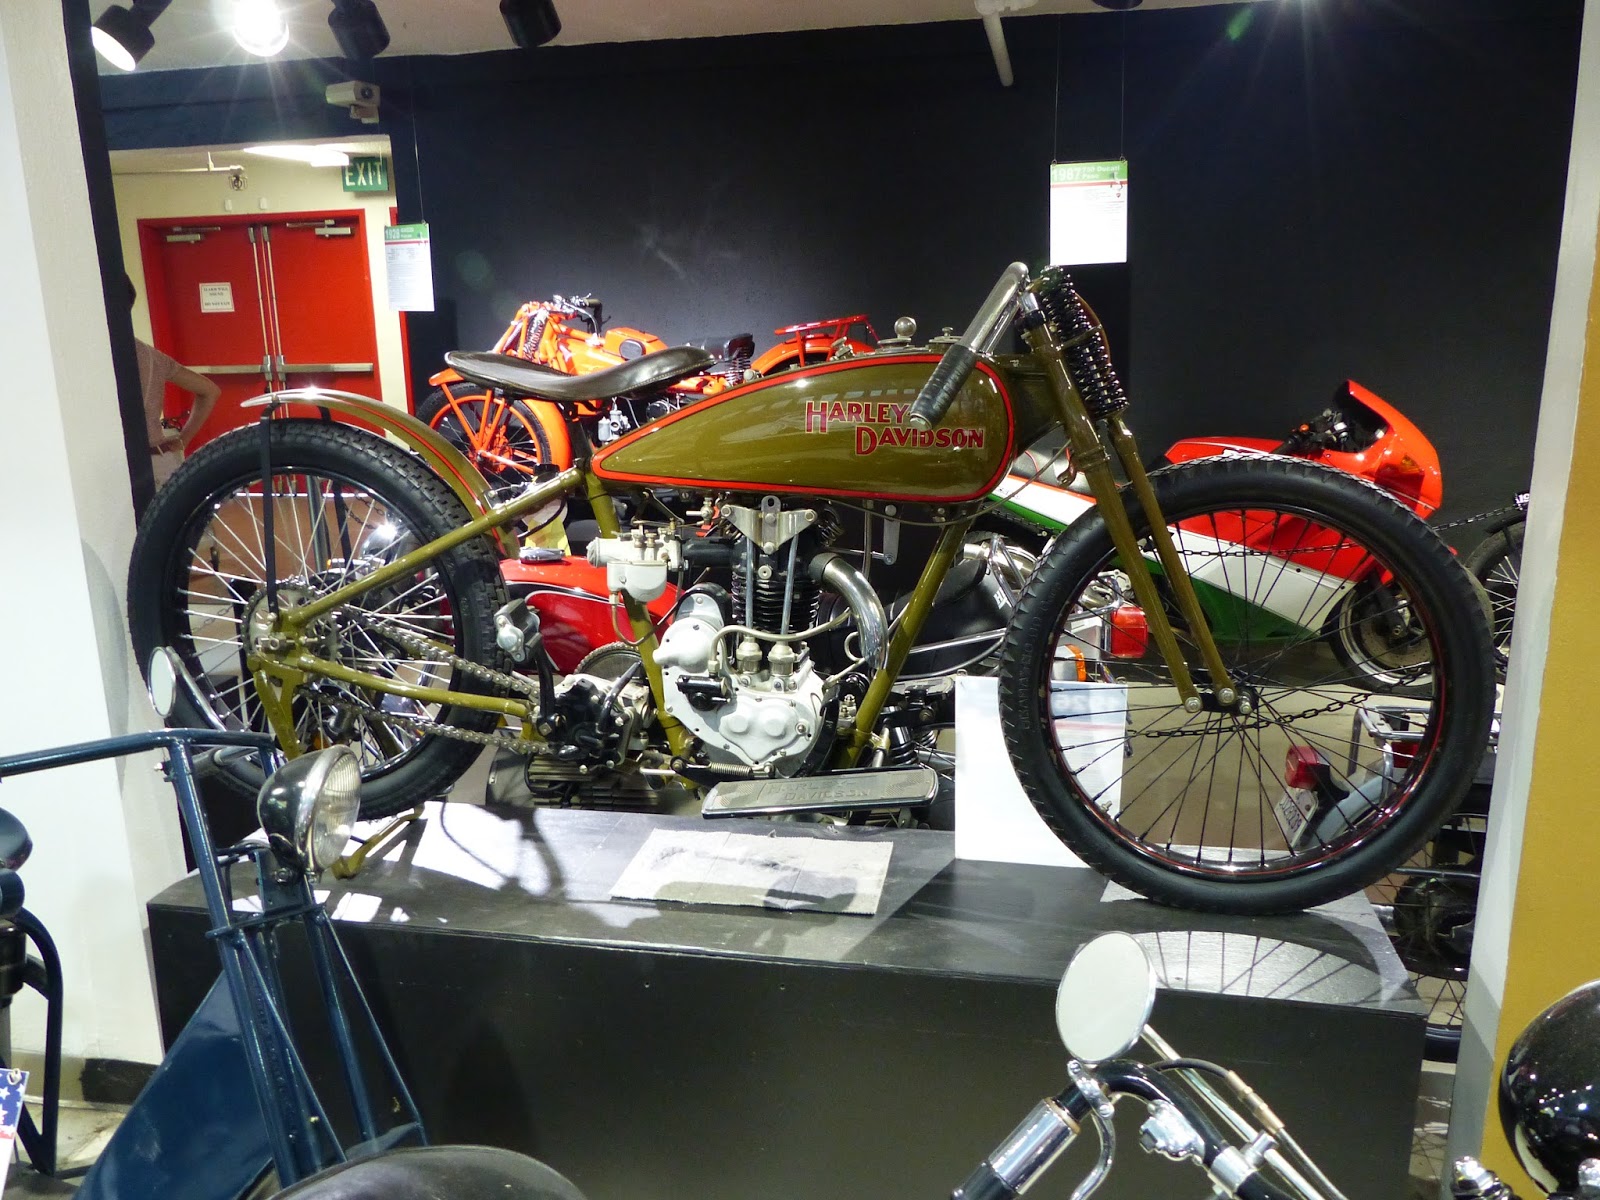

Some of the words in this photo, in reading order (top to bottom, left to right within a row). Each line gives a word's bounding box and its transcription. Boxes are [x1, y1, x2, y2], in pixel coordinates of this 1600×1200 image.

[345, 162, 382, 186] EXIT
[1052, 167, 1081, 181] 1987
[855, 426, 985, 456] DAVIDSON
